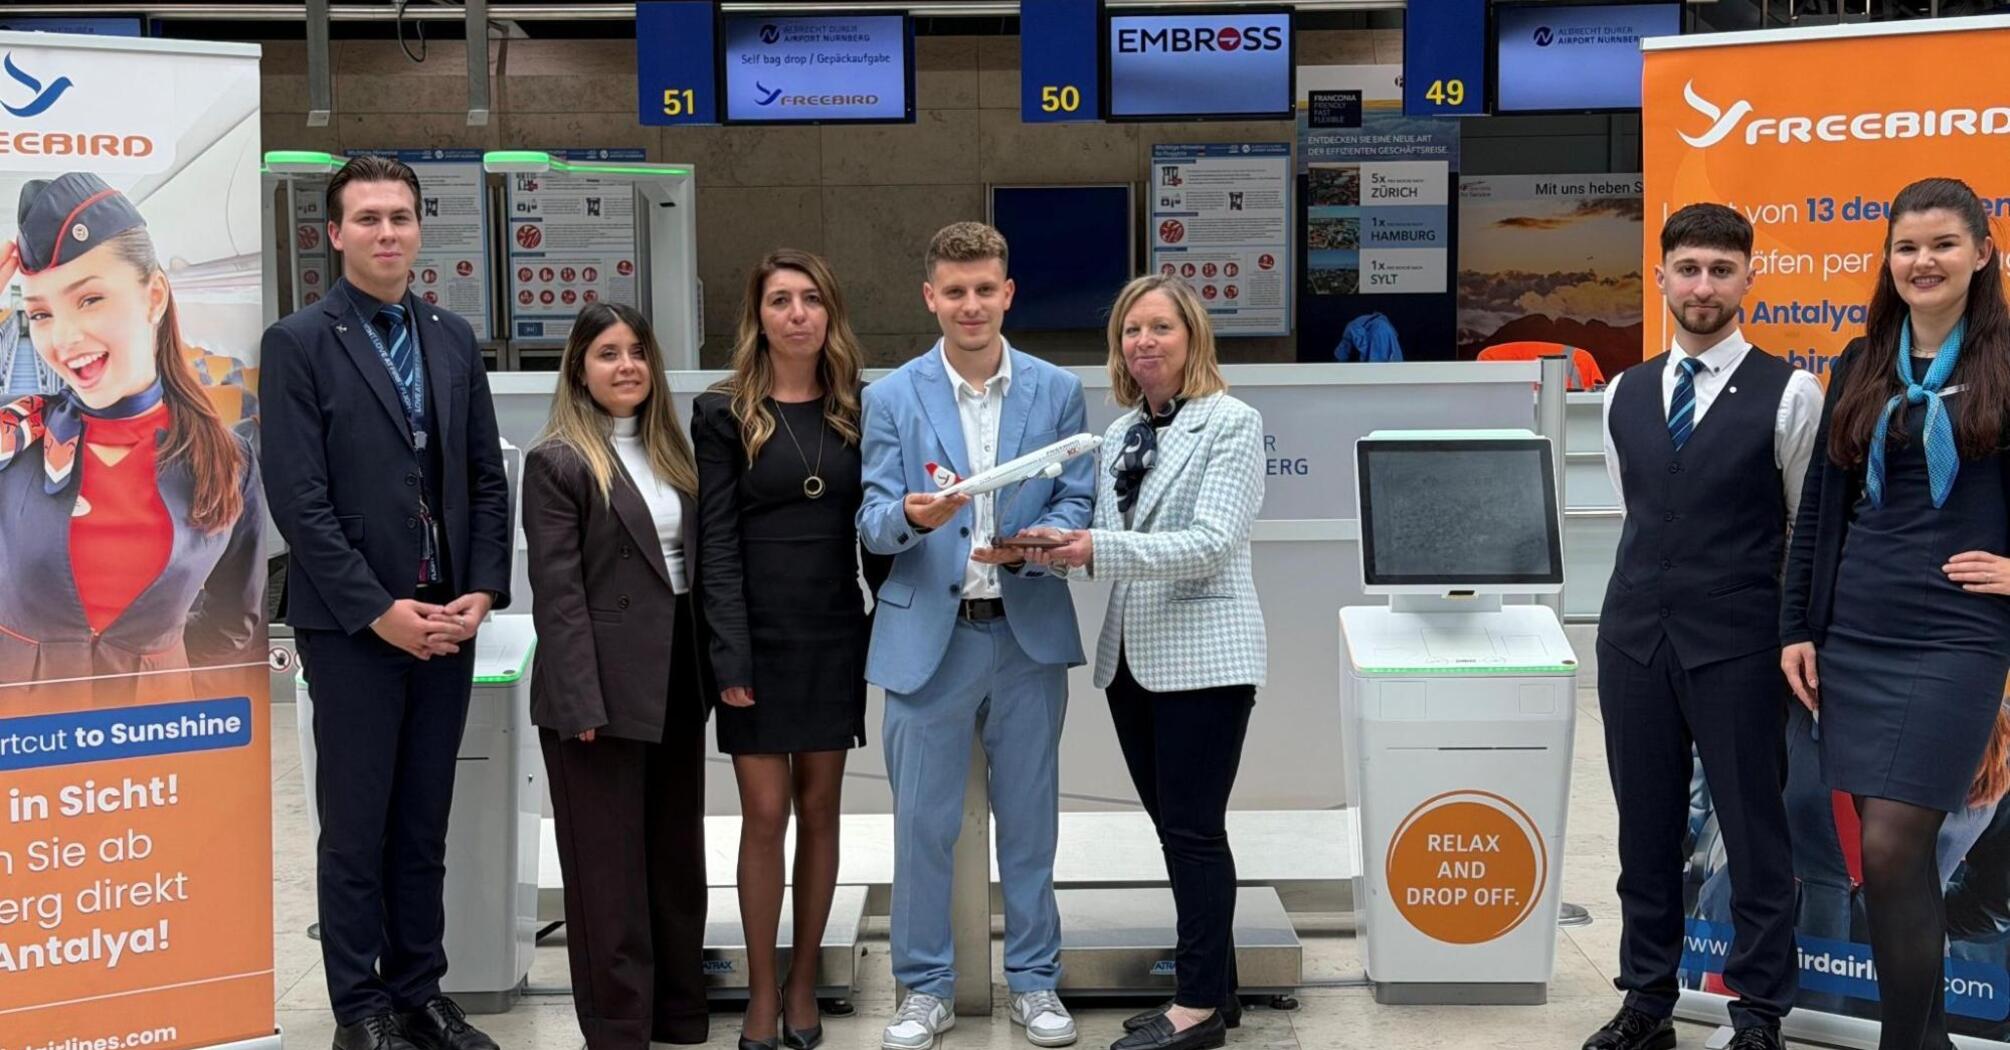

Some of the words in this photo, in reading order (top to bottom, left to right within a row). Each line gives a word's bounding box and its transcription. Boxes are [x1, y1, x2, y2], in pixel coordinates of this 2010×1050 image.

[1118, 26, 1283, 53] EMBROSS
[1557, 36, 1595, 45] AIRPORT
[741, 54, 759, 65] Self
[763, 53, 781, 67] bag
[784, 53, 807, 67] drop
[817, 52, 891, 66] Gepäckaufgabe
[780, 94, 879, 106] FREEBIRD
[1041, 85, 1080, 112] 50
[1313, 94, 1357, 102] FRANCONIA
[1425, 79, 1465, 105] 49
[663, 89, 693, 115] 51
[1745, 107, 2010, 145] FREEBIRD
[1308, 136, 1357, 145] ENTDECKEN
[1373, 135, 1391, 143] EINE
[1393, 135, 1415, 143] NEUE
[1416, 134, 1432, 142] ART
[1308, 147, 1323, 156] DER
[1371, 173, 1386, 184] 5x
[1371, 185, 1418, 198] ZÜRICH
[1535, 183, 1557, 195] Mit
[1561, 183, 1585, 194] uns
[1589, 181, 1630, 194] heben
[1807, 198, 1833, 222] 13
[1371, 217, 1386, 227] 1x
[1371, 230, 1436, 241] HAMBURG
[1371, 261, 1386, 271] 1x
[1823, 253, 1873, 281] per
[1371, 274, 1398, 285] SYLT
[1751, 300, 1867, 332] Antalya
[75, 727, 105, 748] to
[110, 713, 241, 744] Sunshine
[9, 788, 49, 823] in
[59, 774, 179, 817] Sicht!
[27, 836, 86, 871] Sie
[99, 828, 153, 862] ab
[1428, 834, 1500, 852] RELAX
[1437, 861, 1486, 879] AND
[76, 871, 189, 914] direkt
[1407, 888, 1467, 905] DROP
[1474, 889, 1520, 906] OFF.
